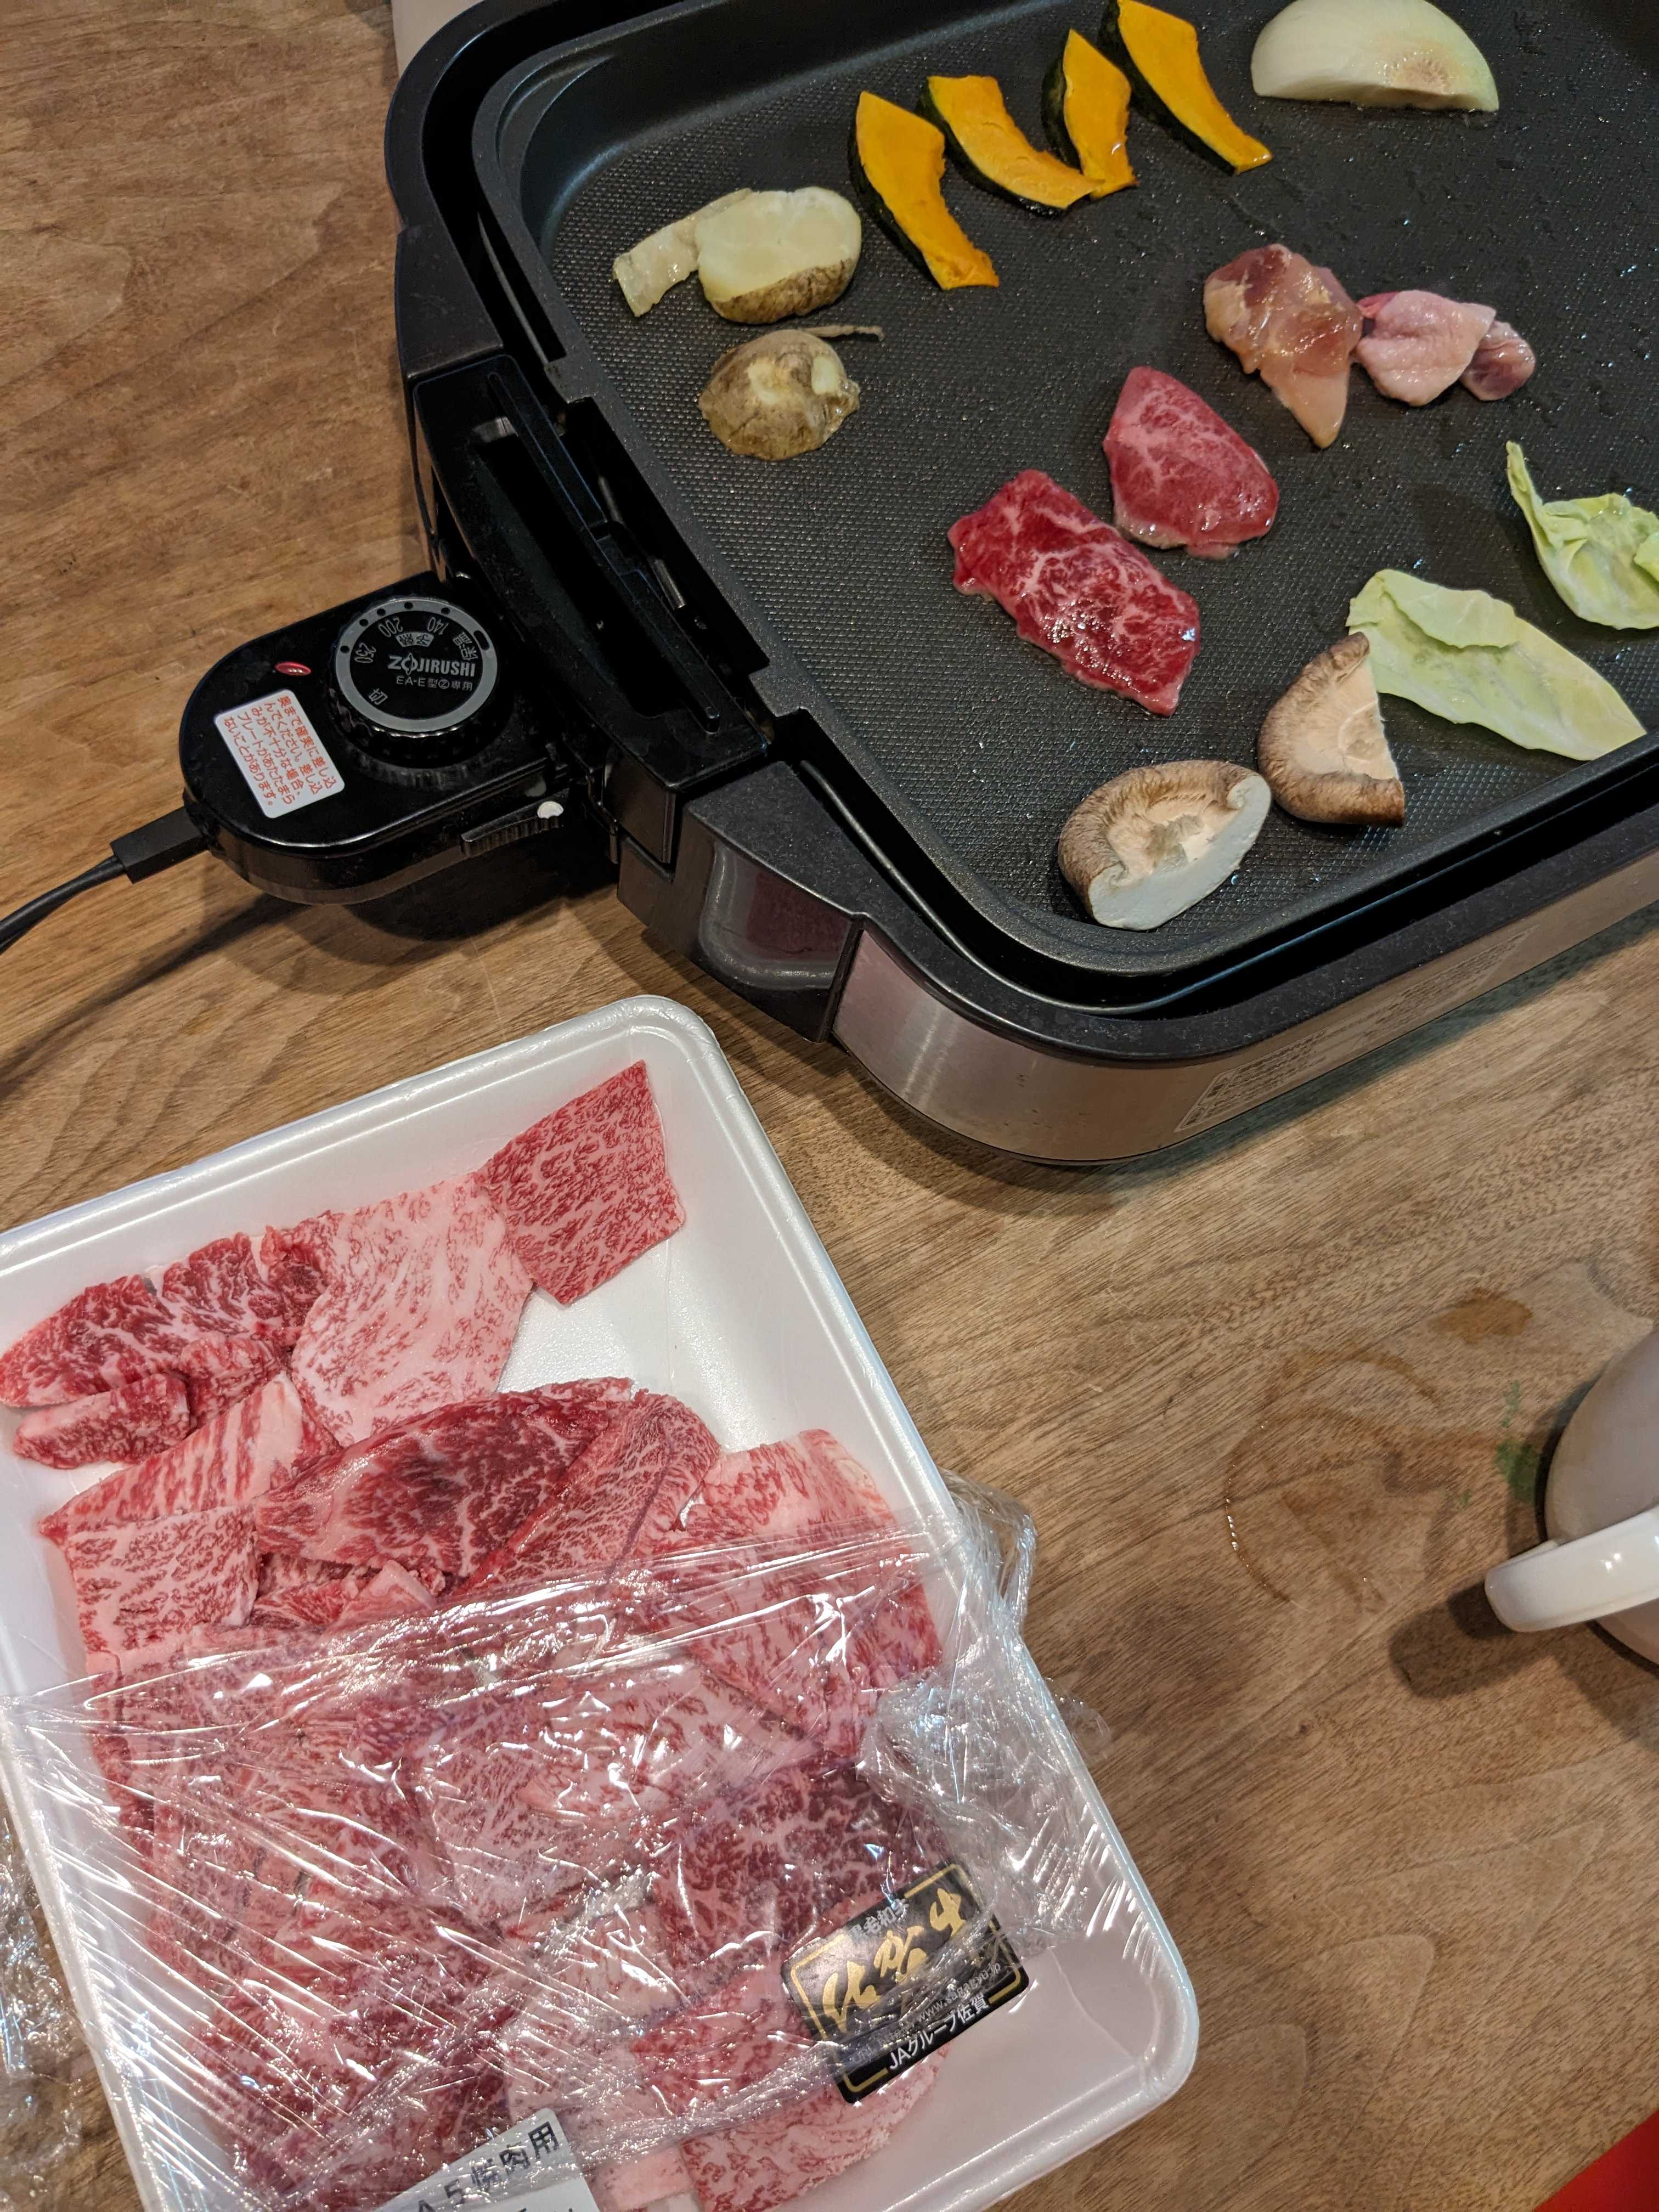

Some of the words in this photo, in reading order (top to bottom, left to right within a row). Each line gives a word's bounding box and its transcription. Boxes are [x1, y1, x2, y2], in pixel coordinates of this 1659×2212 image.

[378, 617, 403, 637] 200
[427, 617, 449, 635] 140
[354, 642, 376, 663] 250
[387, 653, 476, 677] ZOJIRUSHI
[368, 688, 387, 705] 切
